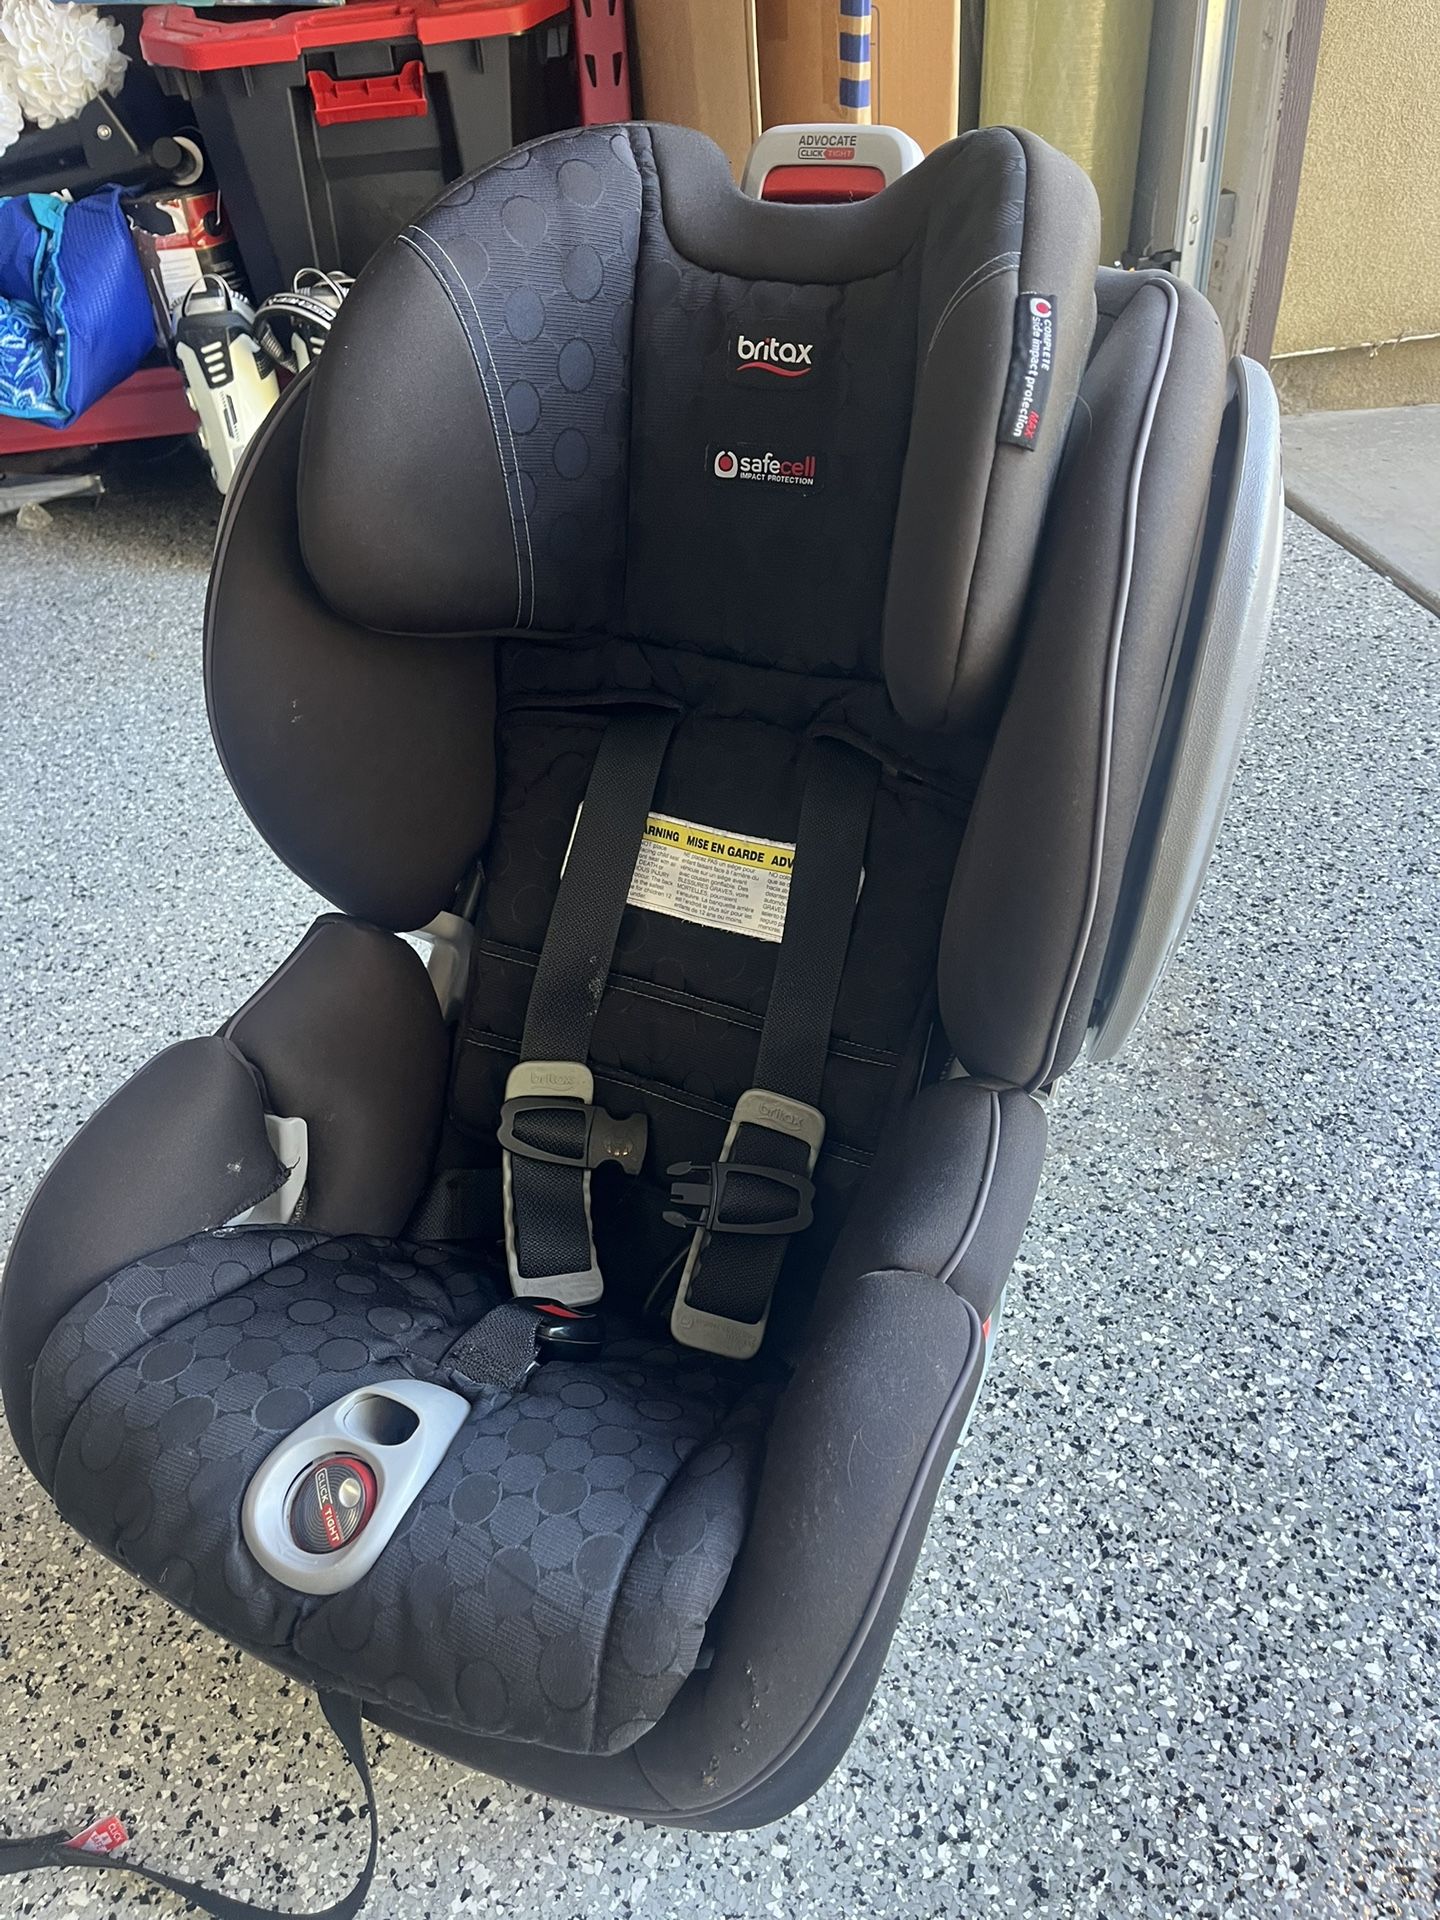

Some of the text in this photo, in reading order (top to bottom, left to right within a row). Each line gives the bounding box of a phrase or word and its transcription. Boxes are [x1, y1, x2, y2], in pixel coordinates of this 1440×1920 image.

[799, 135, 857, 146] ADVOCATE
[738, 335, 813, 364] britax
[1041, 319, 1052, 371] COMPLETE
[1013, 317, 1043, 437] side impact protection
[1024, 411, 1039, 439] MAX
[740, 452, 816, 478] safecell
[740, 472, 814, 485] IMPACT PROTECTION
[686, 835, 709, 850] MISE
[710, 841, 725, 854] EN
[726, 845, 765, 863] GARDE
[638, 858, 658, 868] DEATH
[650, 868, 669, 878] INJURY
[742, 866, 755, 874] pour
[643, 887, 664, 896] children
[730, 910, 744, 918] pour
[760, 1103, 804, 1126] britax
[317, 1472, 340, 1542] CLICK TIGHT
